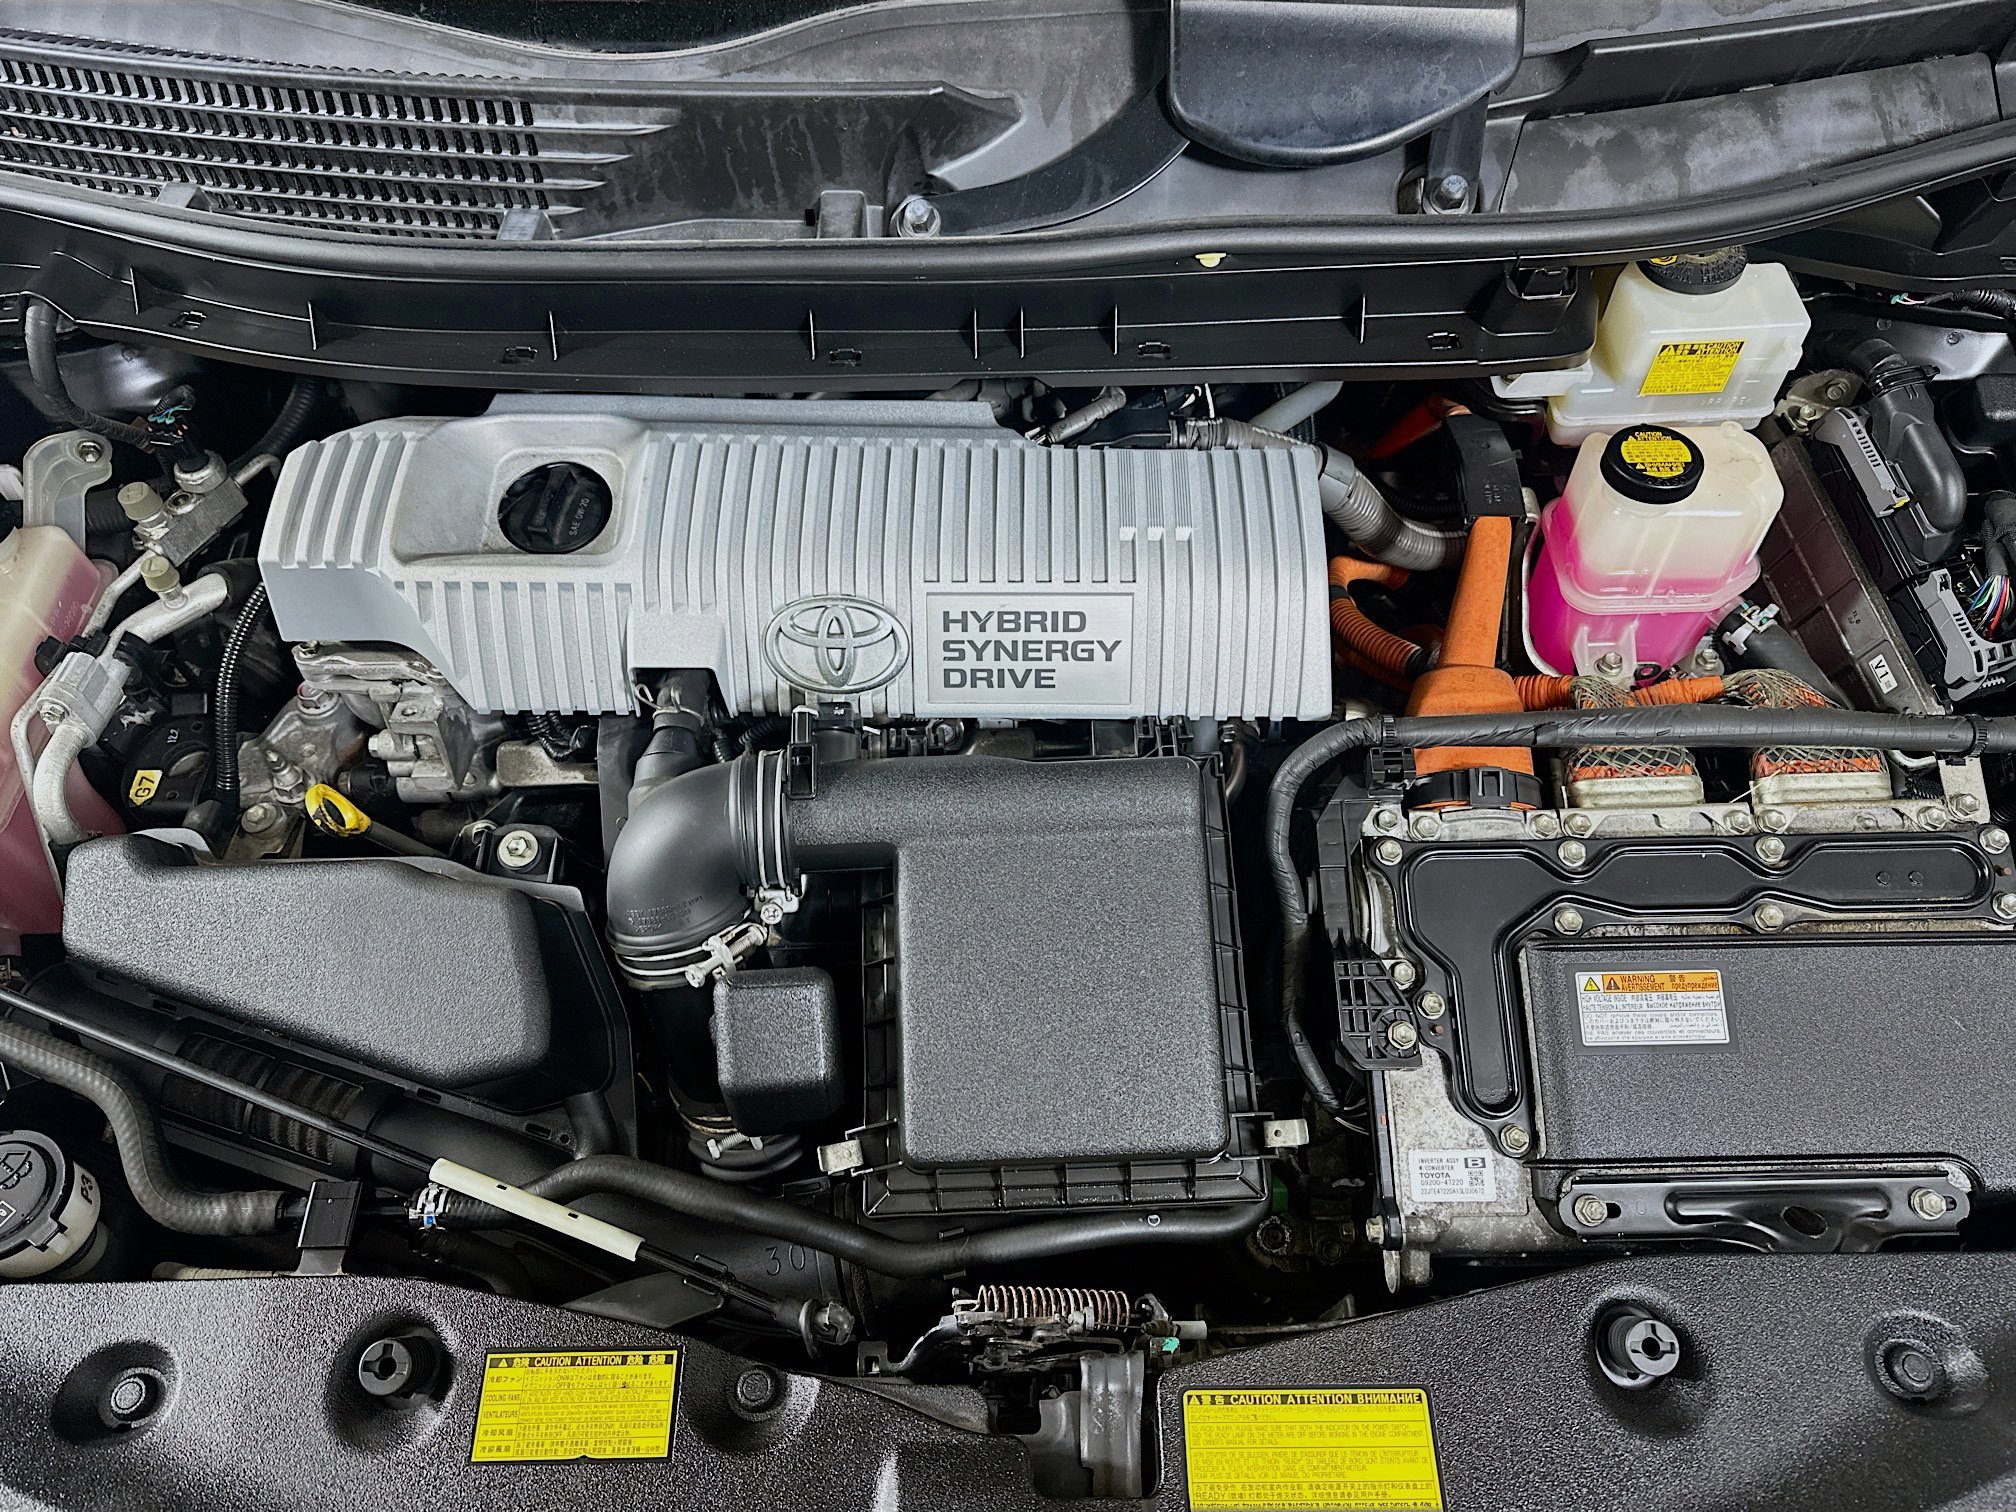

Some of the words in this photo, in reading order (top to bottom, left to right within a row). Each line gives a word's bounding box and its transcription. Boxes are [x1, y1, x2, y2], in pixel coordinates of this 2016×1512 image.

[1707, 342, 1741, 350] CAUTION
[1696, 348, 1738, 356] ATTENTION
[569, 522, 581, 536] SAE
[576, 498, 590, 519] 0W-20
[942, 610, 1086, 632] HYBRID
[942, 638, 1122, 662] SYNERGY
[1874, 660, 1890, 679] V1
[942, 668, 1056, 689] DRIVE
[134, 776, 154, 798] G7
[1668, 974, 1685, 982] 警告
[1621, 982, 1664, 991] AVERTISSEMENT
[1468, 1158, 1483, 1168] B
[764, 1244, 806, 1276] 30
[533, 1356, 570, 1366] CAUTION
[575, 1355, 622, 1365] ATTENTION
[488, 1375, 522, 1383] 冷却ファン
[1202, 1394, 1225, 1405] 警告
[1230, 1394, 1281, 1405] CAUTION
[1287, 1394, 1352, 1404] ATTENTION
[1357, 1393, 1420, 1404] ВНИМАНИЕ
[482, 1410, 518, 1418] VENTILATEURS
[1195, 1492, 1225, 1500] READY
